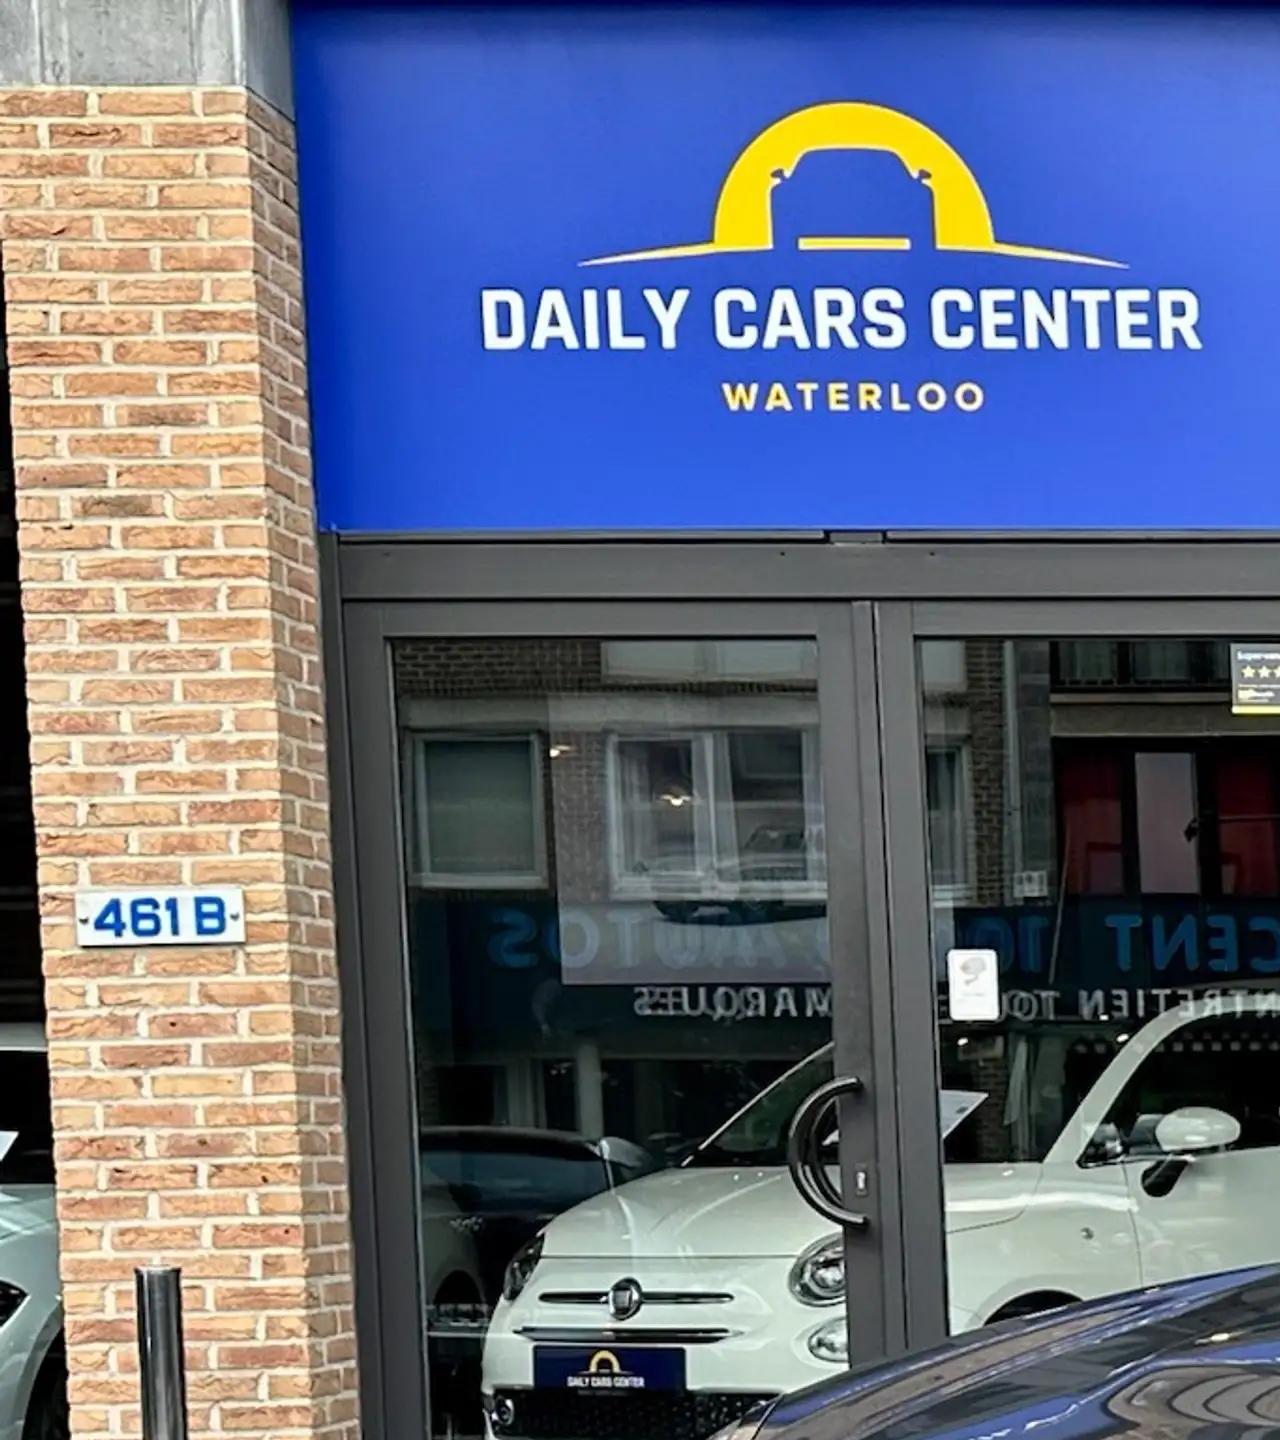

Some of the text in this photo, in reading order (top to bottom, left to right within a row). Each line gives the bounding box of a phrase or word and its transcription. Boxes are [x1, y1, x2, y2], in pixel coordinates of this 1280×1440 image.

[481, 287, 1203, 351] DAILY CARS CENTER
[721, 382, 985, 412] WATERLOO
[94, 896, 227, 938] 461 B
